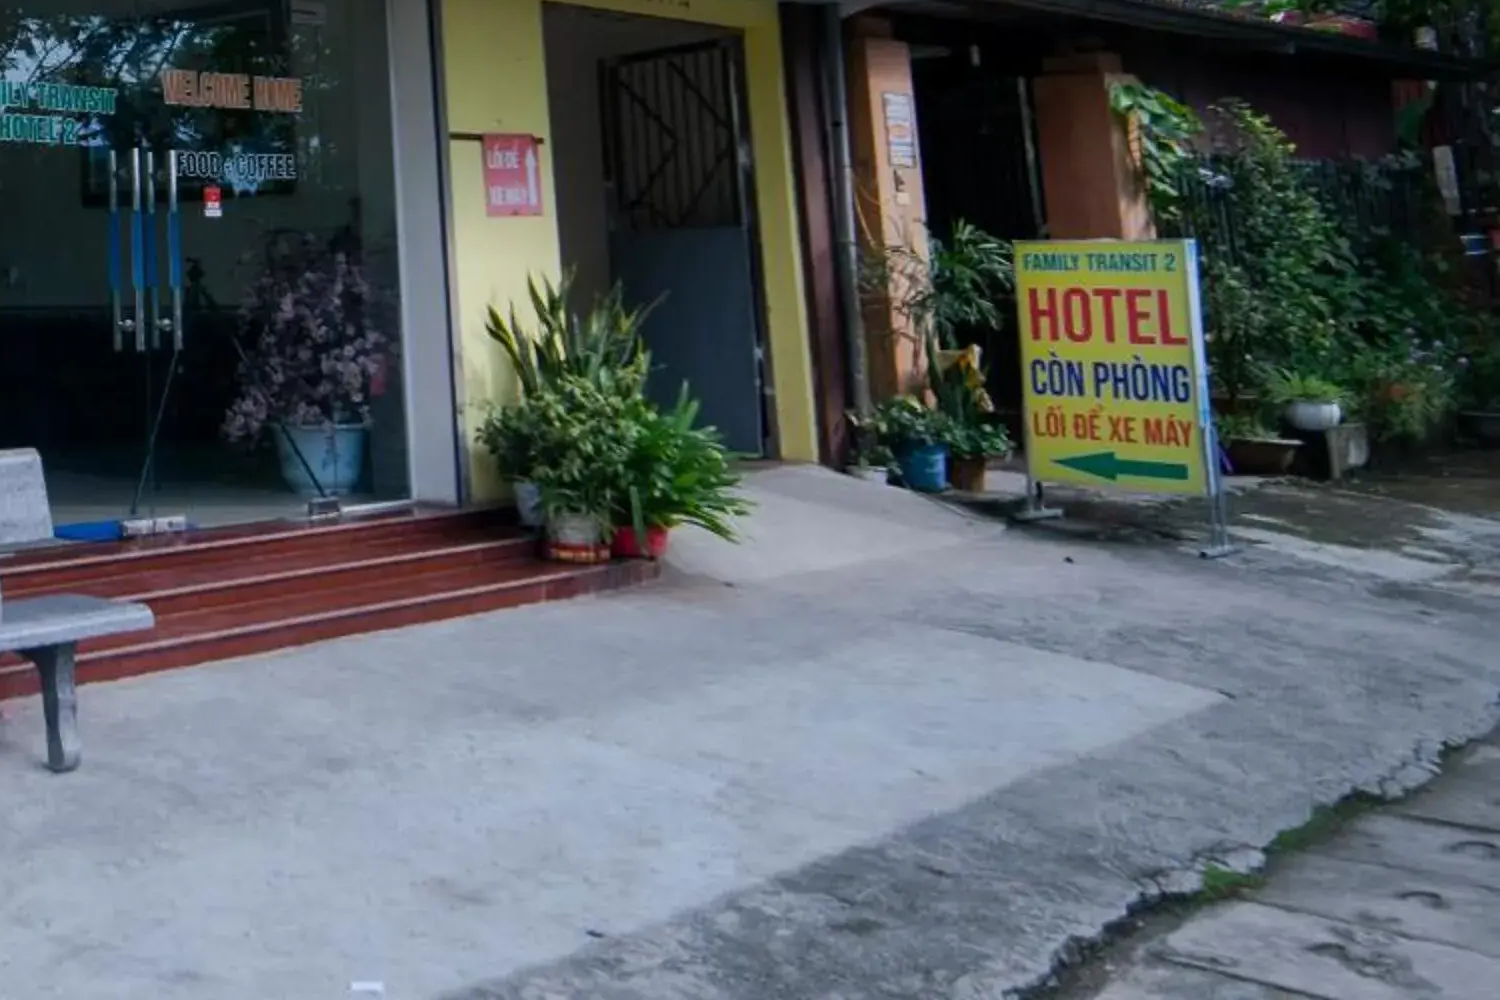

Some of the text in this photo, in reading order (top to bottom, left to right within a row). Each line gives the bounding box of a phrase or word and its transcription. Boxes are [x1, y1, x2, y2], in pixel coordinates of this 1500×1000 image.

[35, 81, 118, 116] TRANSIT
[162, 68, 303, 113] WELCOME HOME
[177, 151, 222, 179] FOOD
[235, 152, 297, 180] COFFEE
[1023, 252, 1177, 273] FAMILY TRANSIT 2
[1027, 286, 1189, 346] HOTEL
[1030, 350, 1191, 404] CÒN PHÒNG
[1107, 415, 1137, 445] XE
[1143, 413, 1193, 448] MÁY
